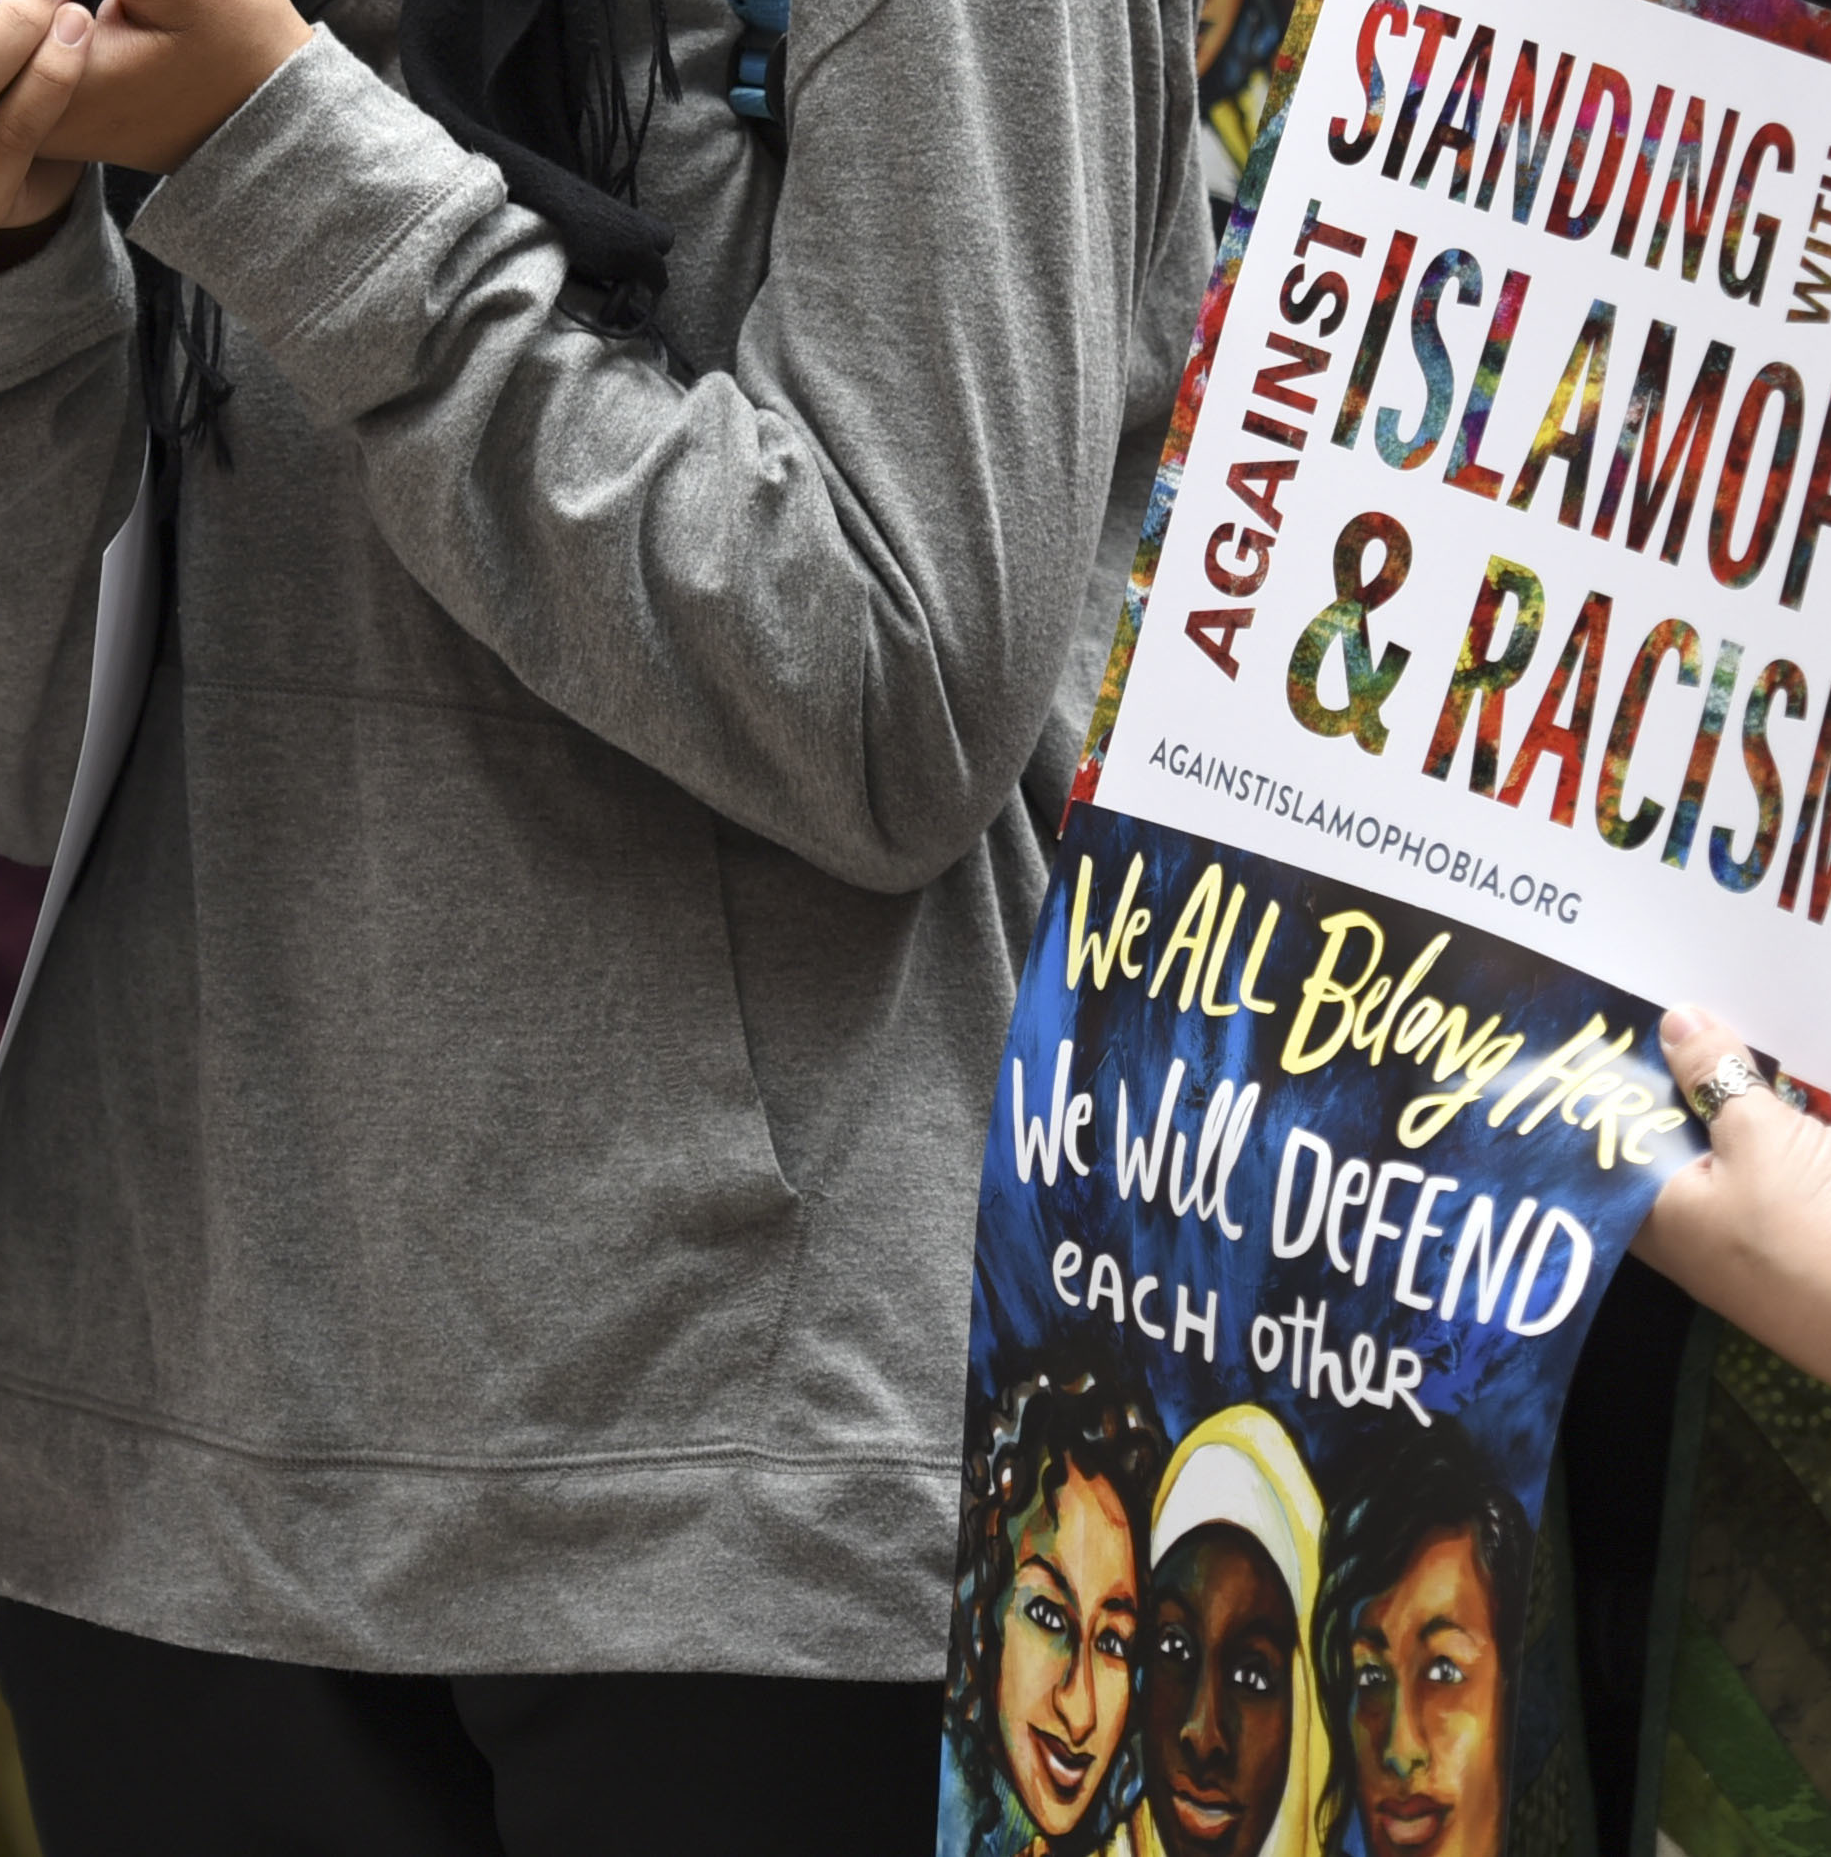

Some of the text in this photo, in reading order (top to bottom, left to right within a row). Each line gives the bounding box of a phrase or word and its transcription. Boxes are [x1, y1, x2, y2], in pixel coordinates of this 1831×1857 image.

[1184, 198, 1367, 681] AGAINST
[1286, 510, 1412, 756] &
[1147, 737, 1583, 926] AGAINSTISLAMOPHOBIA.ORG
[1066, 852, 1151, 992] We
[1148, 863, 1279, 1016] ALL
[1012, 1040, 1091, 1187] We
[1115, 1059, 1260, 1240] Will
